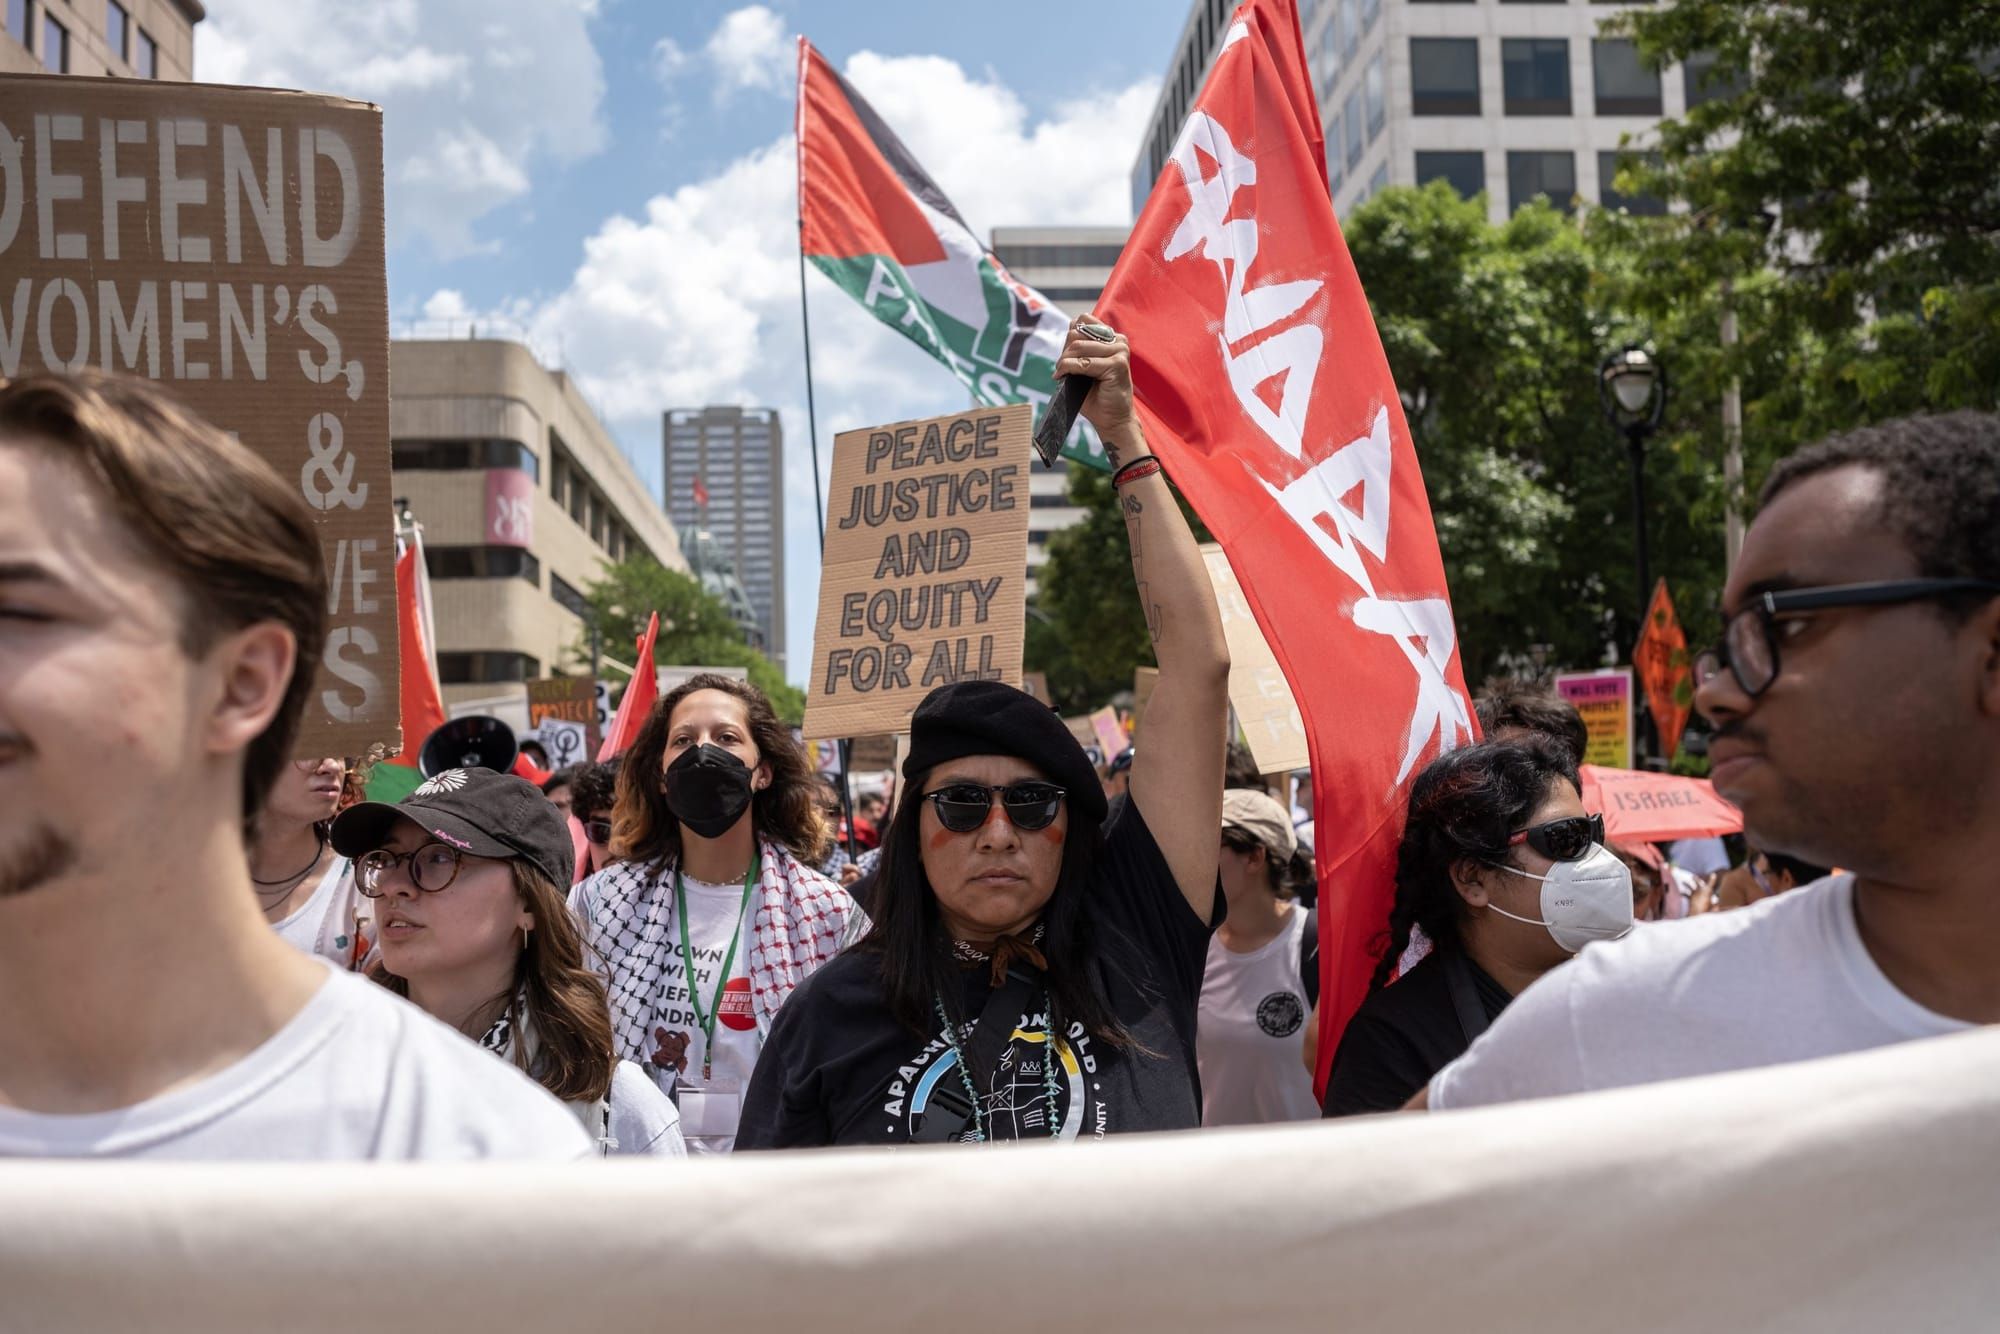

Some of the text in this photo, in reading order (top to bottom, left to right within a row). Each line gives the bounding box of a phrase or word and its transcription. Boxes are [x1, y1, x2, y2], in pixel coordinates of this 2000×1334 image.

[301, 412, 368, 511] &
[866, 416, 1001, 474] PEACE
[839, 465, 1017, 529] JUSTICE
[874, 528, 971, 579] AND
[840, 576, 1003, 642] EQUITY
[825, 635, 1002, 695] FOR ALL
[1595, 683, 1617, 695] VOTE
[1613, 789, 1701, 811] ISRAEL
[1554, 899, 1575, 907] KN95
[660, 962, 711, 983] WIH
[1094, 1101, 1107, 1141] UNITY
